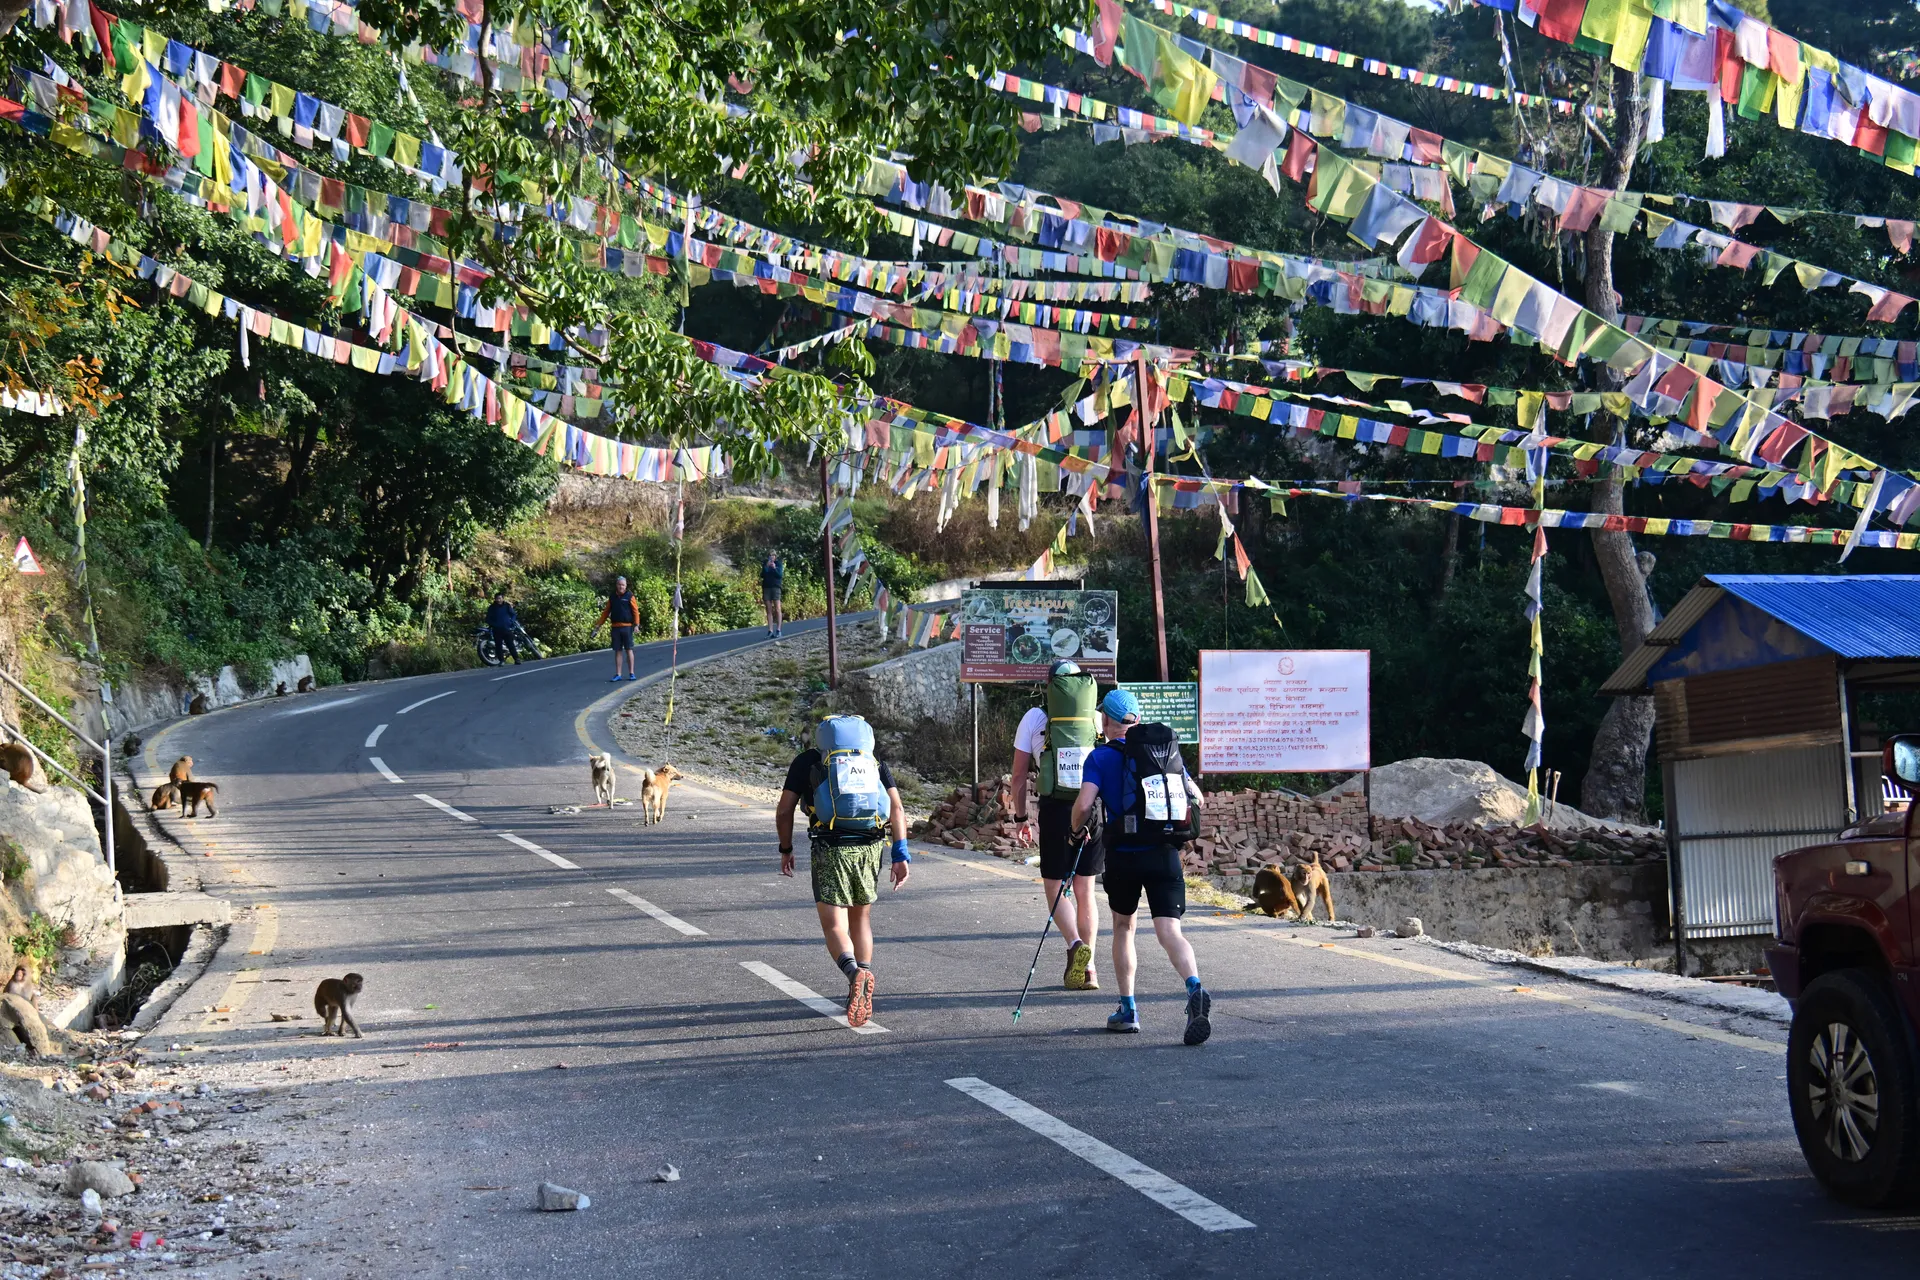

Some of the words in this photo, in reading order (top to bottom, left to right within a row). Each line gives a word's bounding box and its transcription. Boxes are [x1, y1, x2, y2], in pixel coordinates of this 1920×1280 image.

[1003, 596, 1031, 609] Tree
[1034, 596, 1075, 611] House
[1148, 790, 1184, 799] Ricard
